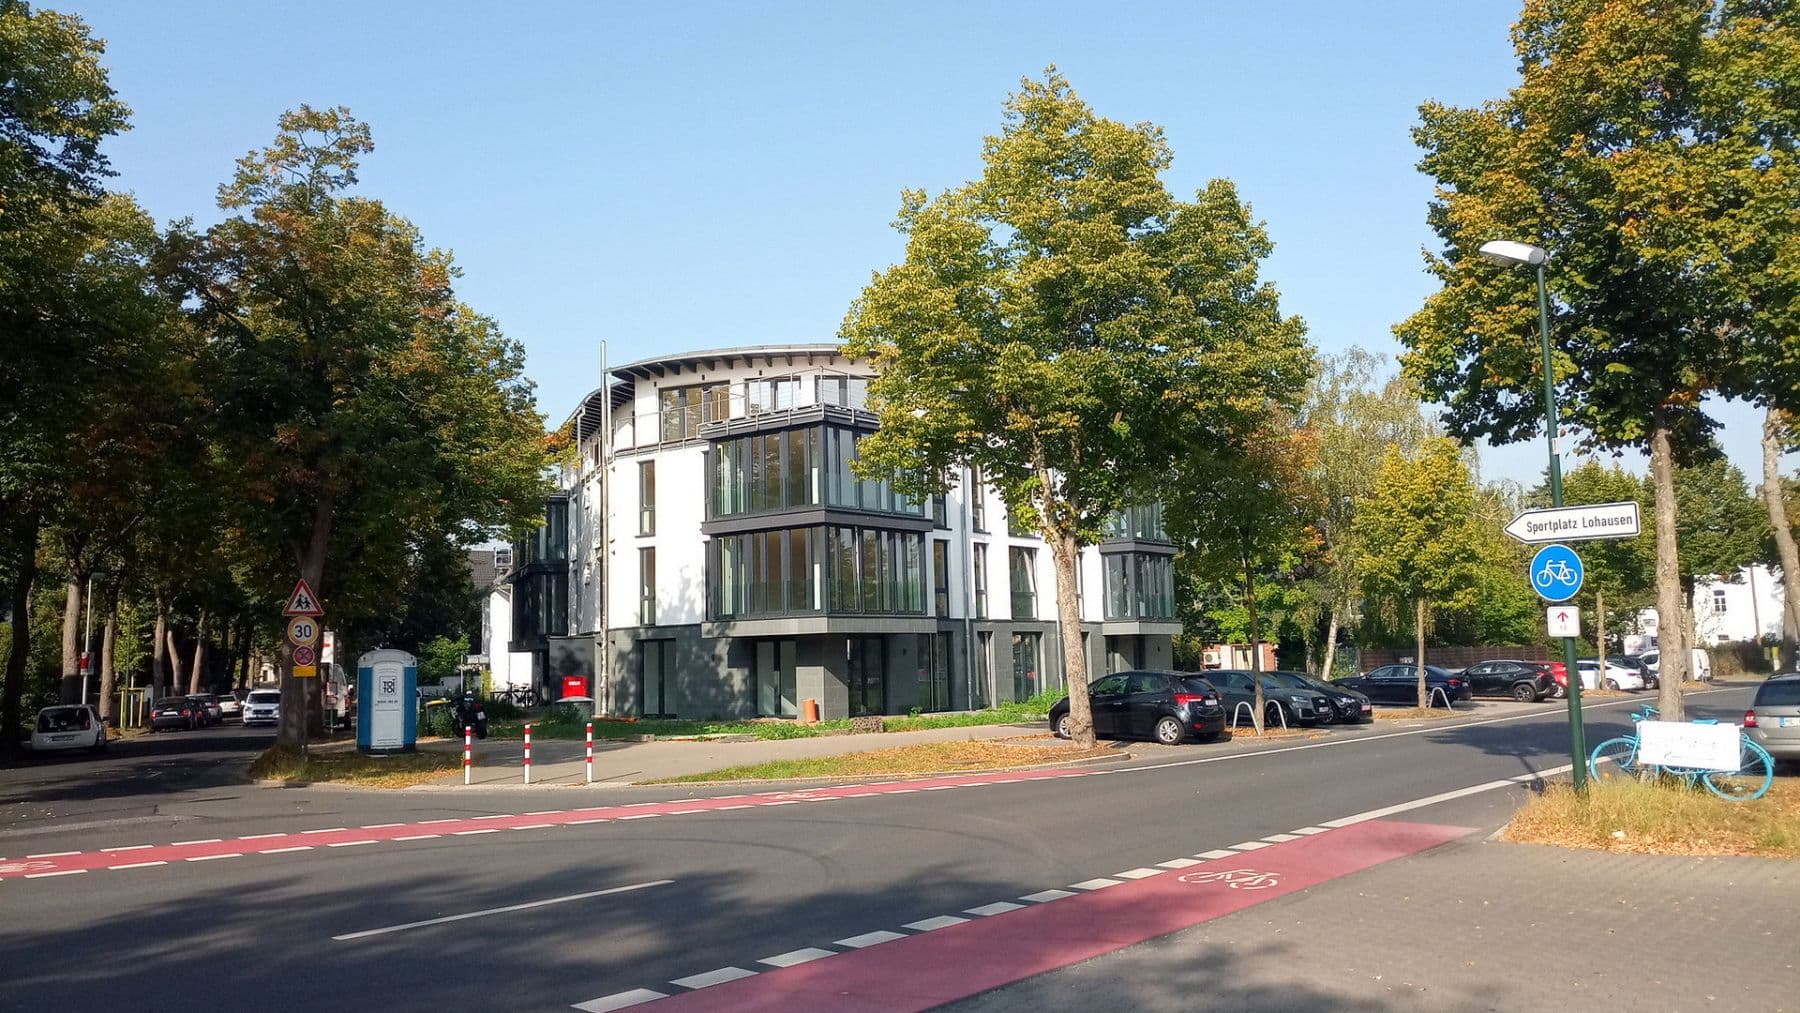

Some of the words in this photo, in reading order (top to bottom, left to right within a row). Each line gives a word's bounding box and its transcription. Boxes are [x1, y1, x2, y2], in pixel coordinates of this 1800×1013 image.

[1526, 518, 1578, 534] Sportplatz
[1582, 515, 1633, 528] Lohausen
[294, 624, 312, 638] 30
